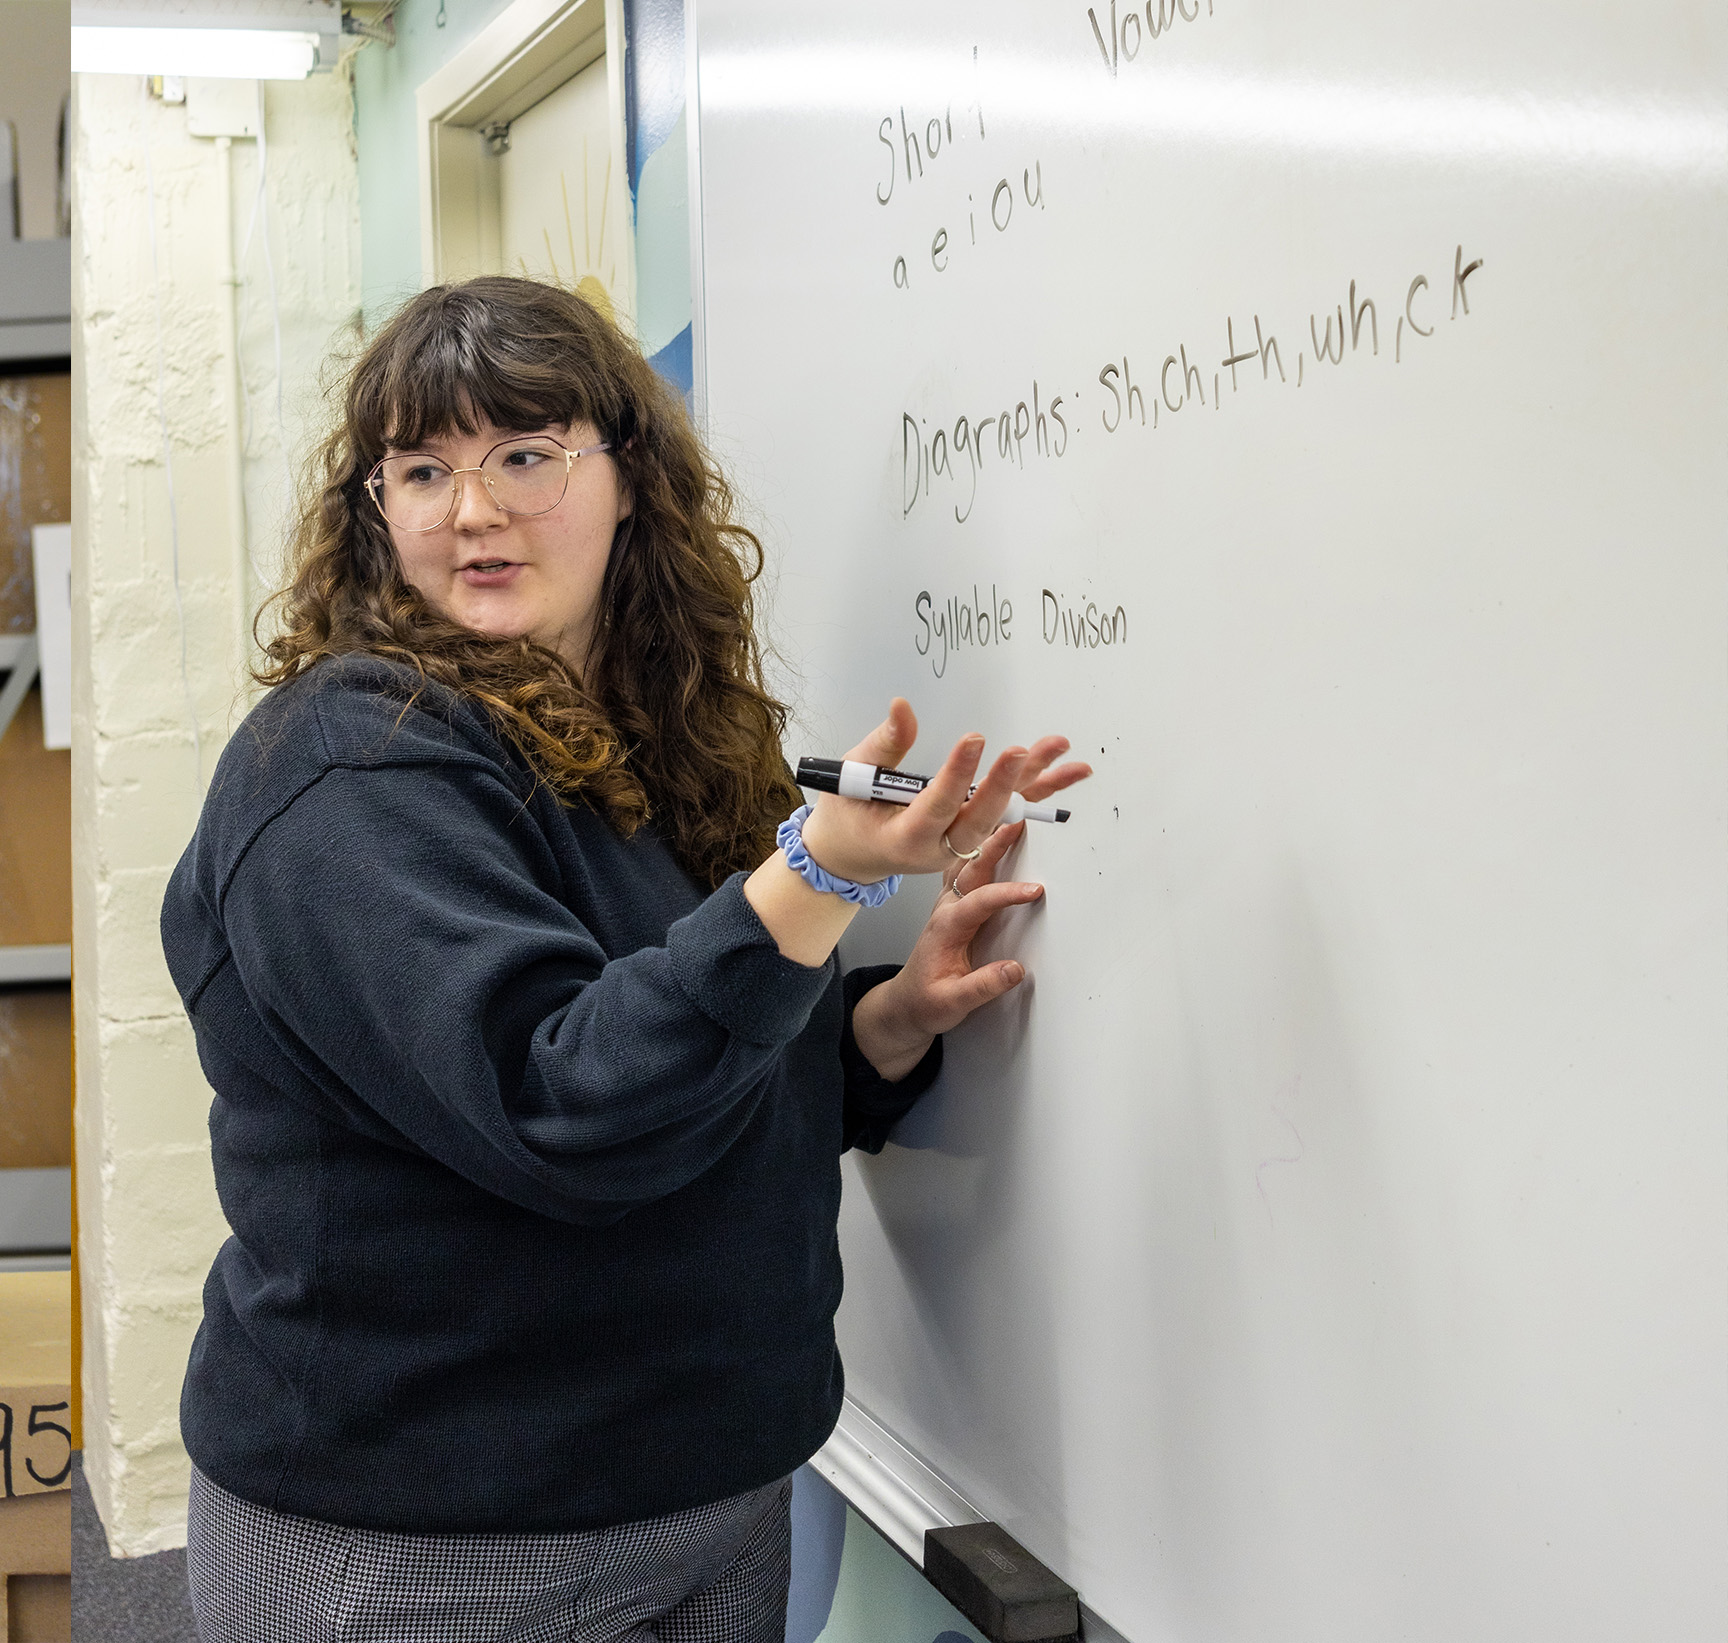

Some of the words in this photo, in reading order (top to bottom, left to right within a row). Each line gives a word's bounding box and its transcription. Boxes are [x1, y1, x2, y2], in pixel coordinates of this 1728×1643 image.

[1087, 0, 1214, 79] Vow
[903, 379, 1081, 523] Diagraphs:
[915, 583, 1013, 679] Syllable
[884, 776, 903, 784] odor
[904, 779, 919, 788] low
